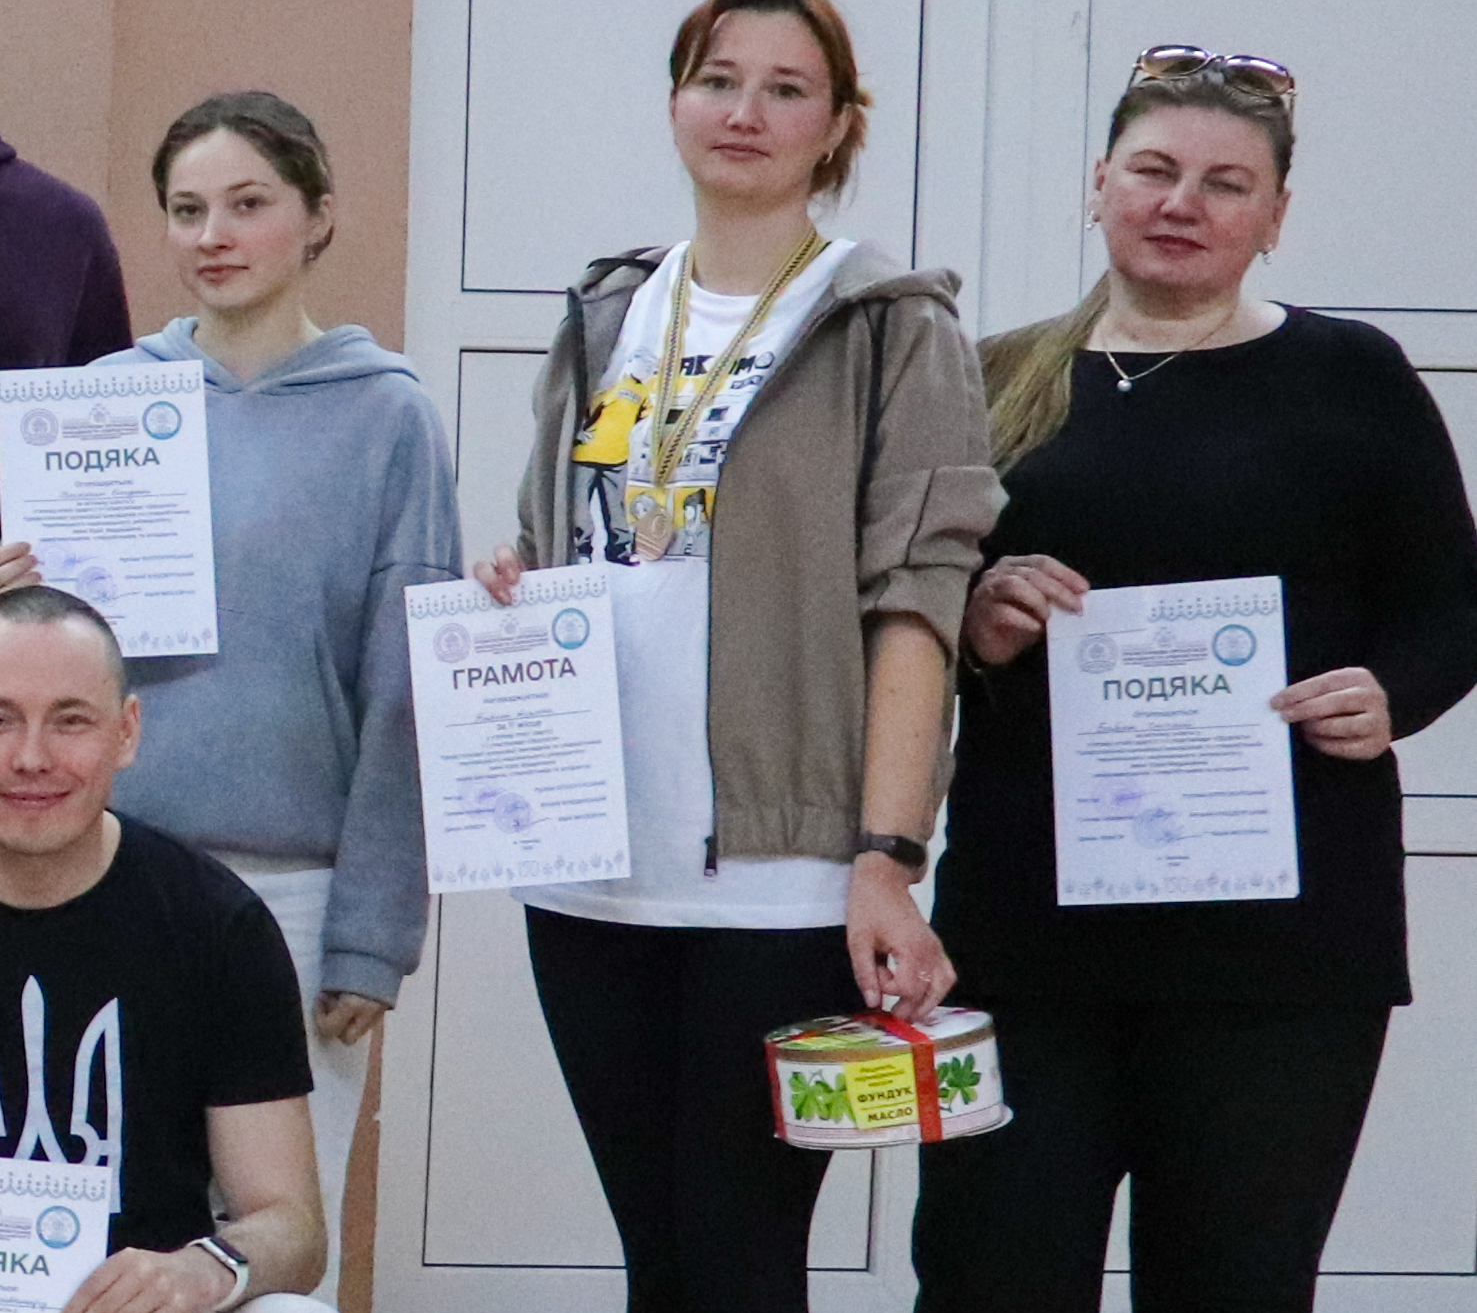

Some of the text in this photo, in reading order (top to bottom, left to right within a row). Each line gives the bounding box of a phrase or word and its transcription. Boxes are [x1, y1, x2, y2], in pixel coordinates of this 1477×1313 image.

[45, 446, 161, 473] ПОДЯКА
[452, 657, 577, 690] ГРАМОТА
[1102, 673, 1232, 702] ПОДЯКА
[857, 1086, 914, 1103] ФУНДУК
[868, 1107, 913, 1122] МАСЛО
